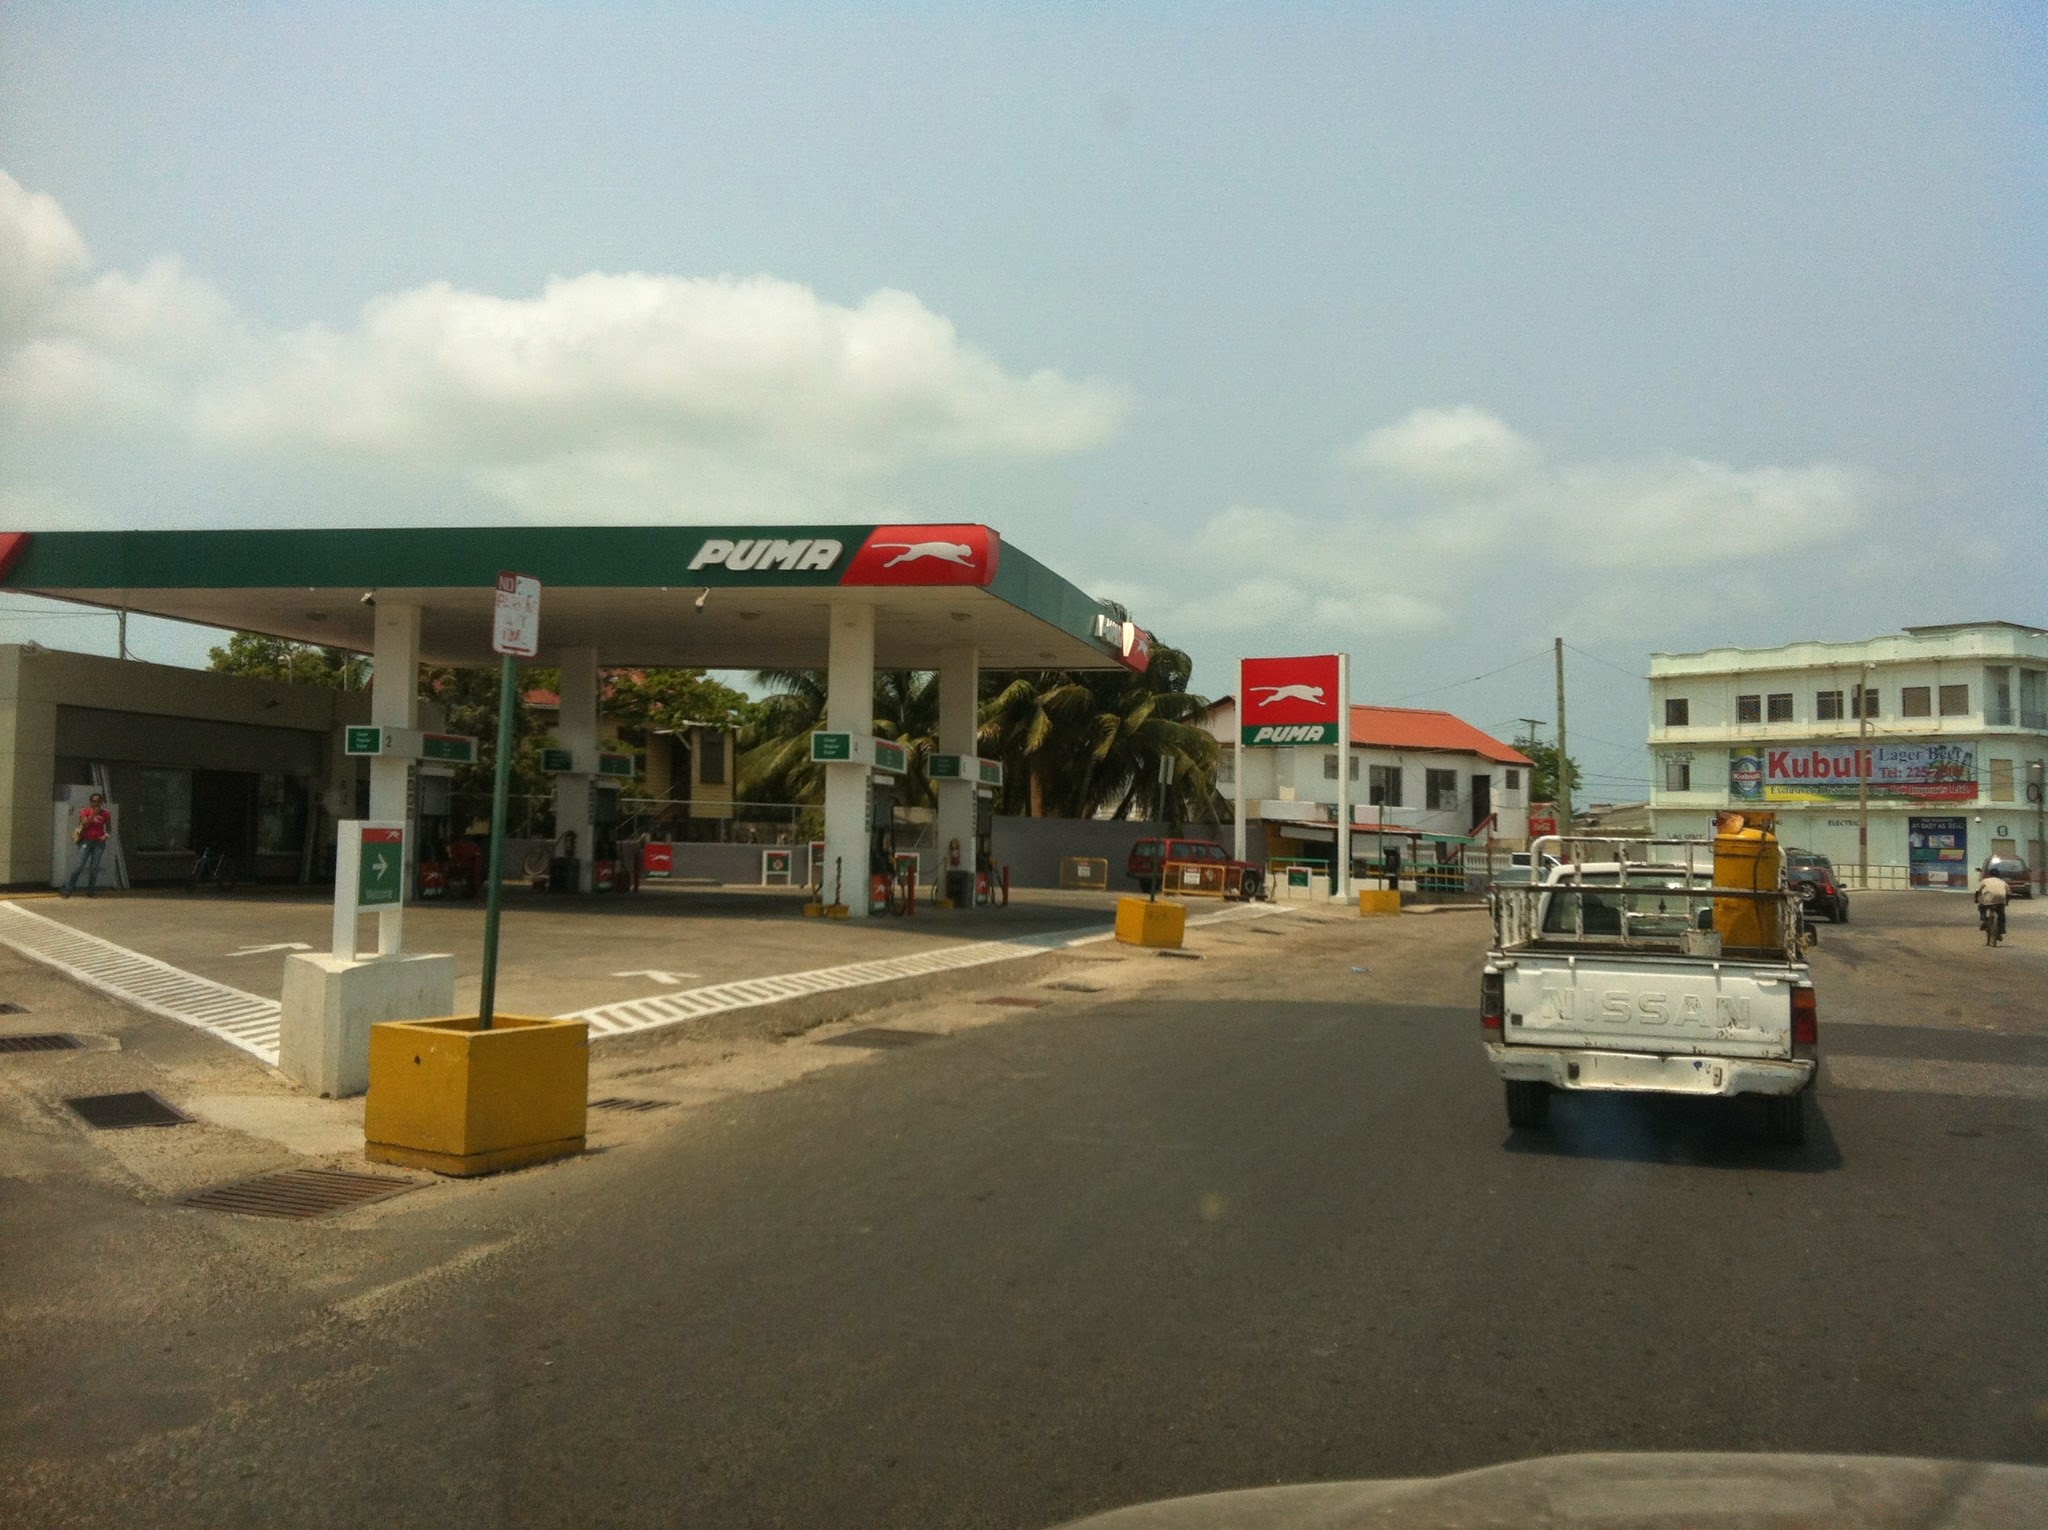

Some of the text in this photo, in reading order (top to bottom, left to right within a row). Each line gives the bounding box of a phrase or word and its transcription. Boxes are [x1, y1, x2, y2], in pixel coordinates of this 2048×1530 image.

[687, 538, 844, 572] PUMA
[385, 735, 393, 748] 2
[1253, 725, 1325, 743] PUMA
[1768, 750, 1873, 779] Kubuli
[1879, 748, 1923, 763] Lager
[1879, 767, 1902, 778] Tel:
[1542, 986, 1751, 1030] NISSAN
